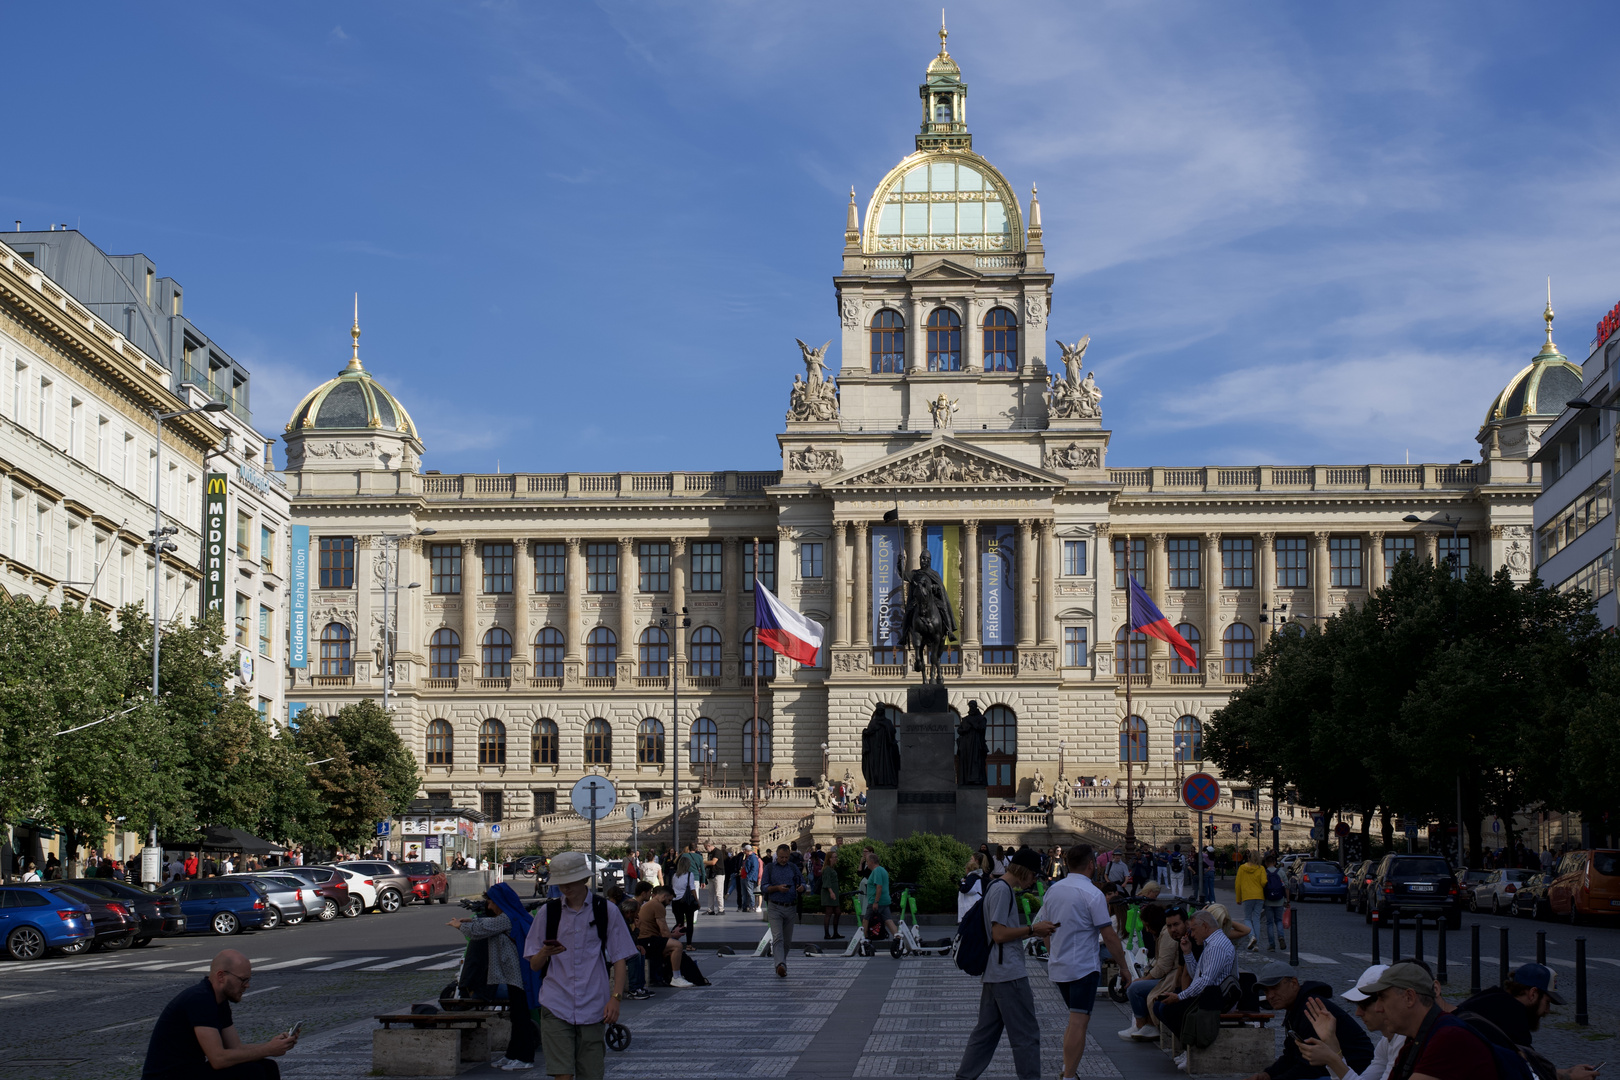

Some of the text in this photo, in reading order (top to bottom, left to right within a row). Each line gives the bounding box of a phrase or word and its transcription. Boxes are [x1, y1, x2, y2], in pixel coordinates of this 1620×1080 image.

[294, 548, 305, 661] Occidental Praha Wilson
[879, 533, 889, 640] HISTORIE HISTORY
[987, 539, 999, 639] PŘÍRODA NATURE
